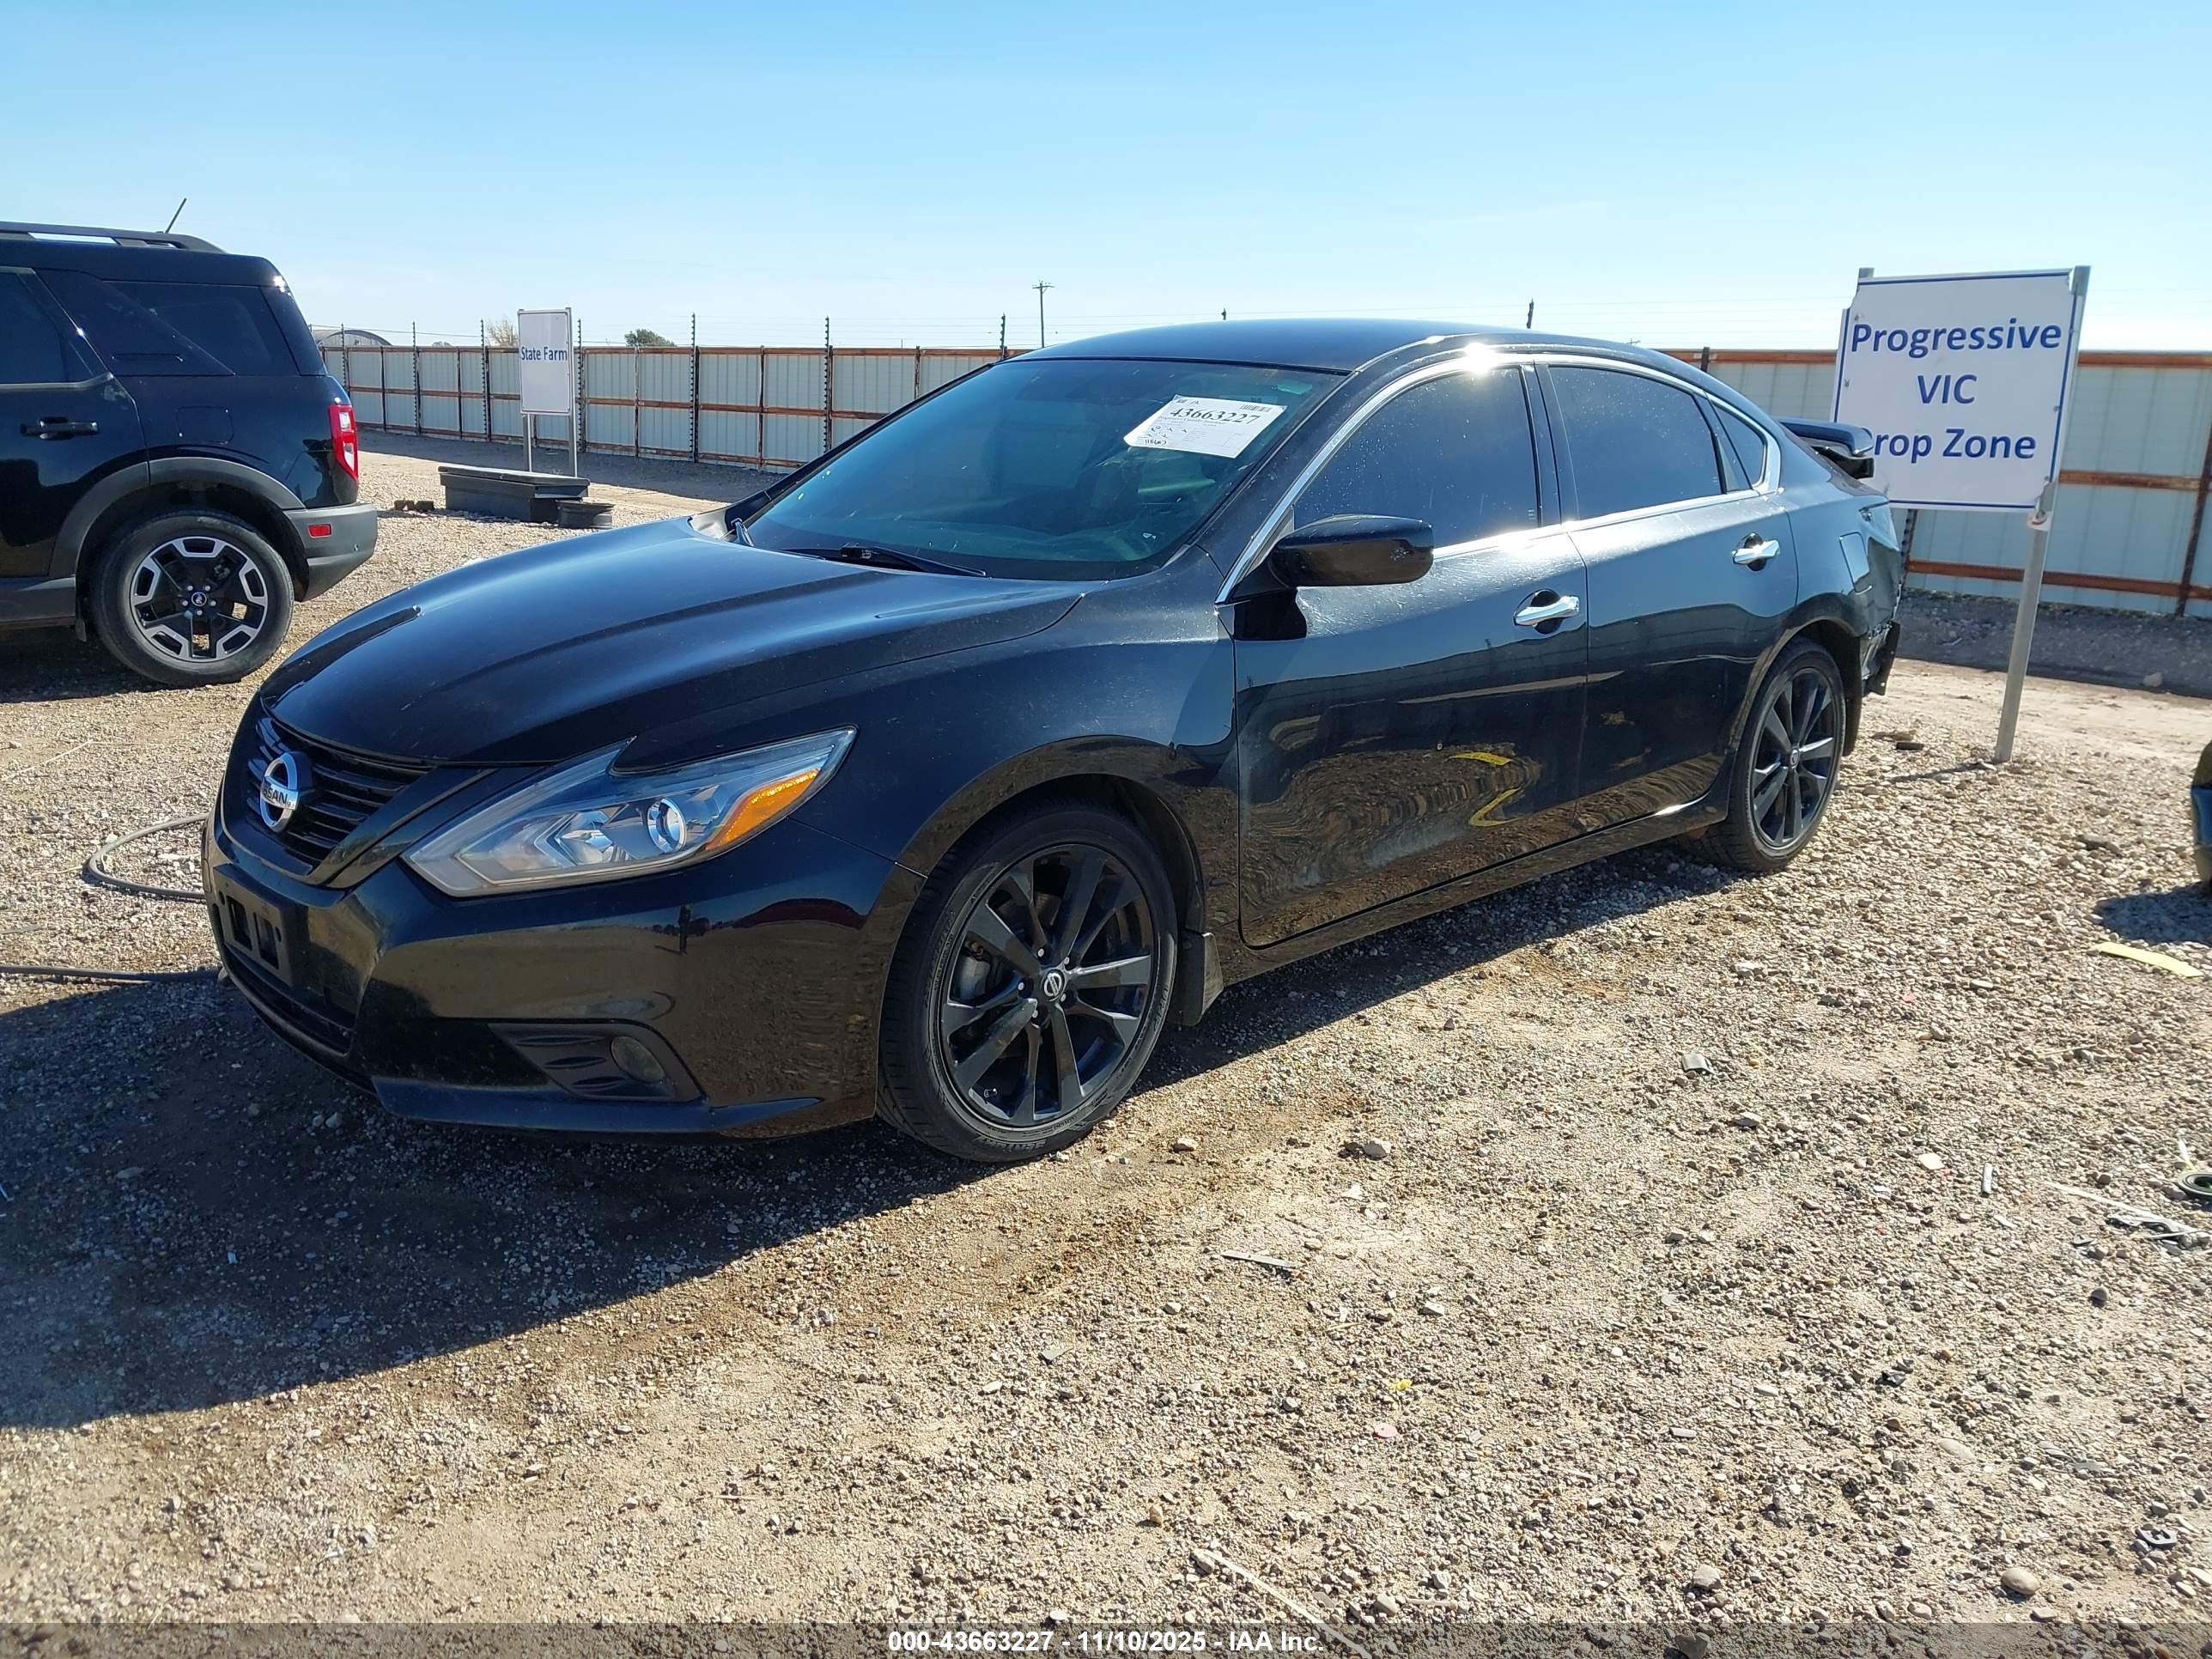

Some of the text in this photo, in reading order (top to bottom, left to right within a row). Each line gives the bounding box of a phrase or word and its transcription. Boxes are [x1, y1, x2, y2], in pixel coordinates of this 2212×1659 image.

[1851, 317, 2062, 359] Progressive
[520, 346, 567, 361] State Farm
[1917, 374, 1978, 404] VIC
[1170, 407, 1261, 424] 43663227
[1875, 428, 2036, 464] rop Zone
